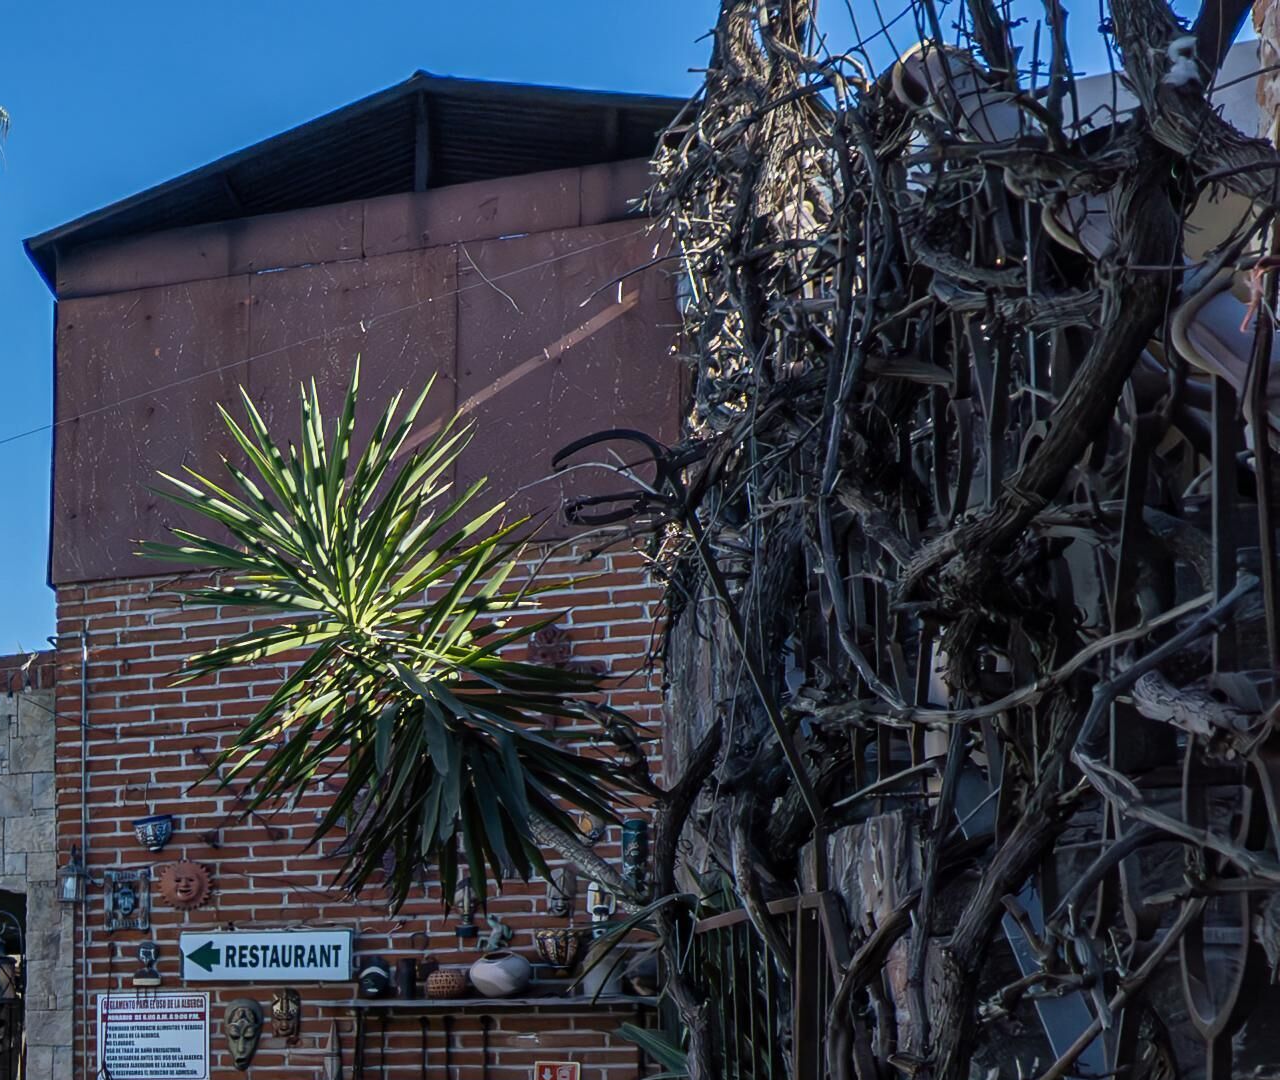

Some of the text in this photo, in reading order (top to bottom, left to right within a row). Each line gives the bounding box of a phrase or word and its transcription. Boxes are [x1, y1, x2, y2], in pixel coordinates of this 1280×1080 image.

[224, 944, 342, 968] RESTAURANT
[156, 999, 166, 1009] USO
[167, 999, 173, 1009] DE
[174, 998, 180, 1008] LA
[181, 998, 204, 1008] ALBERCA
